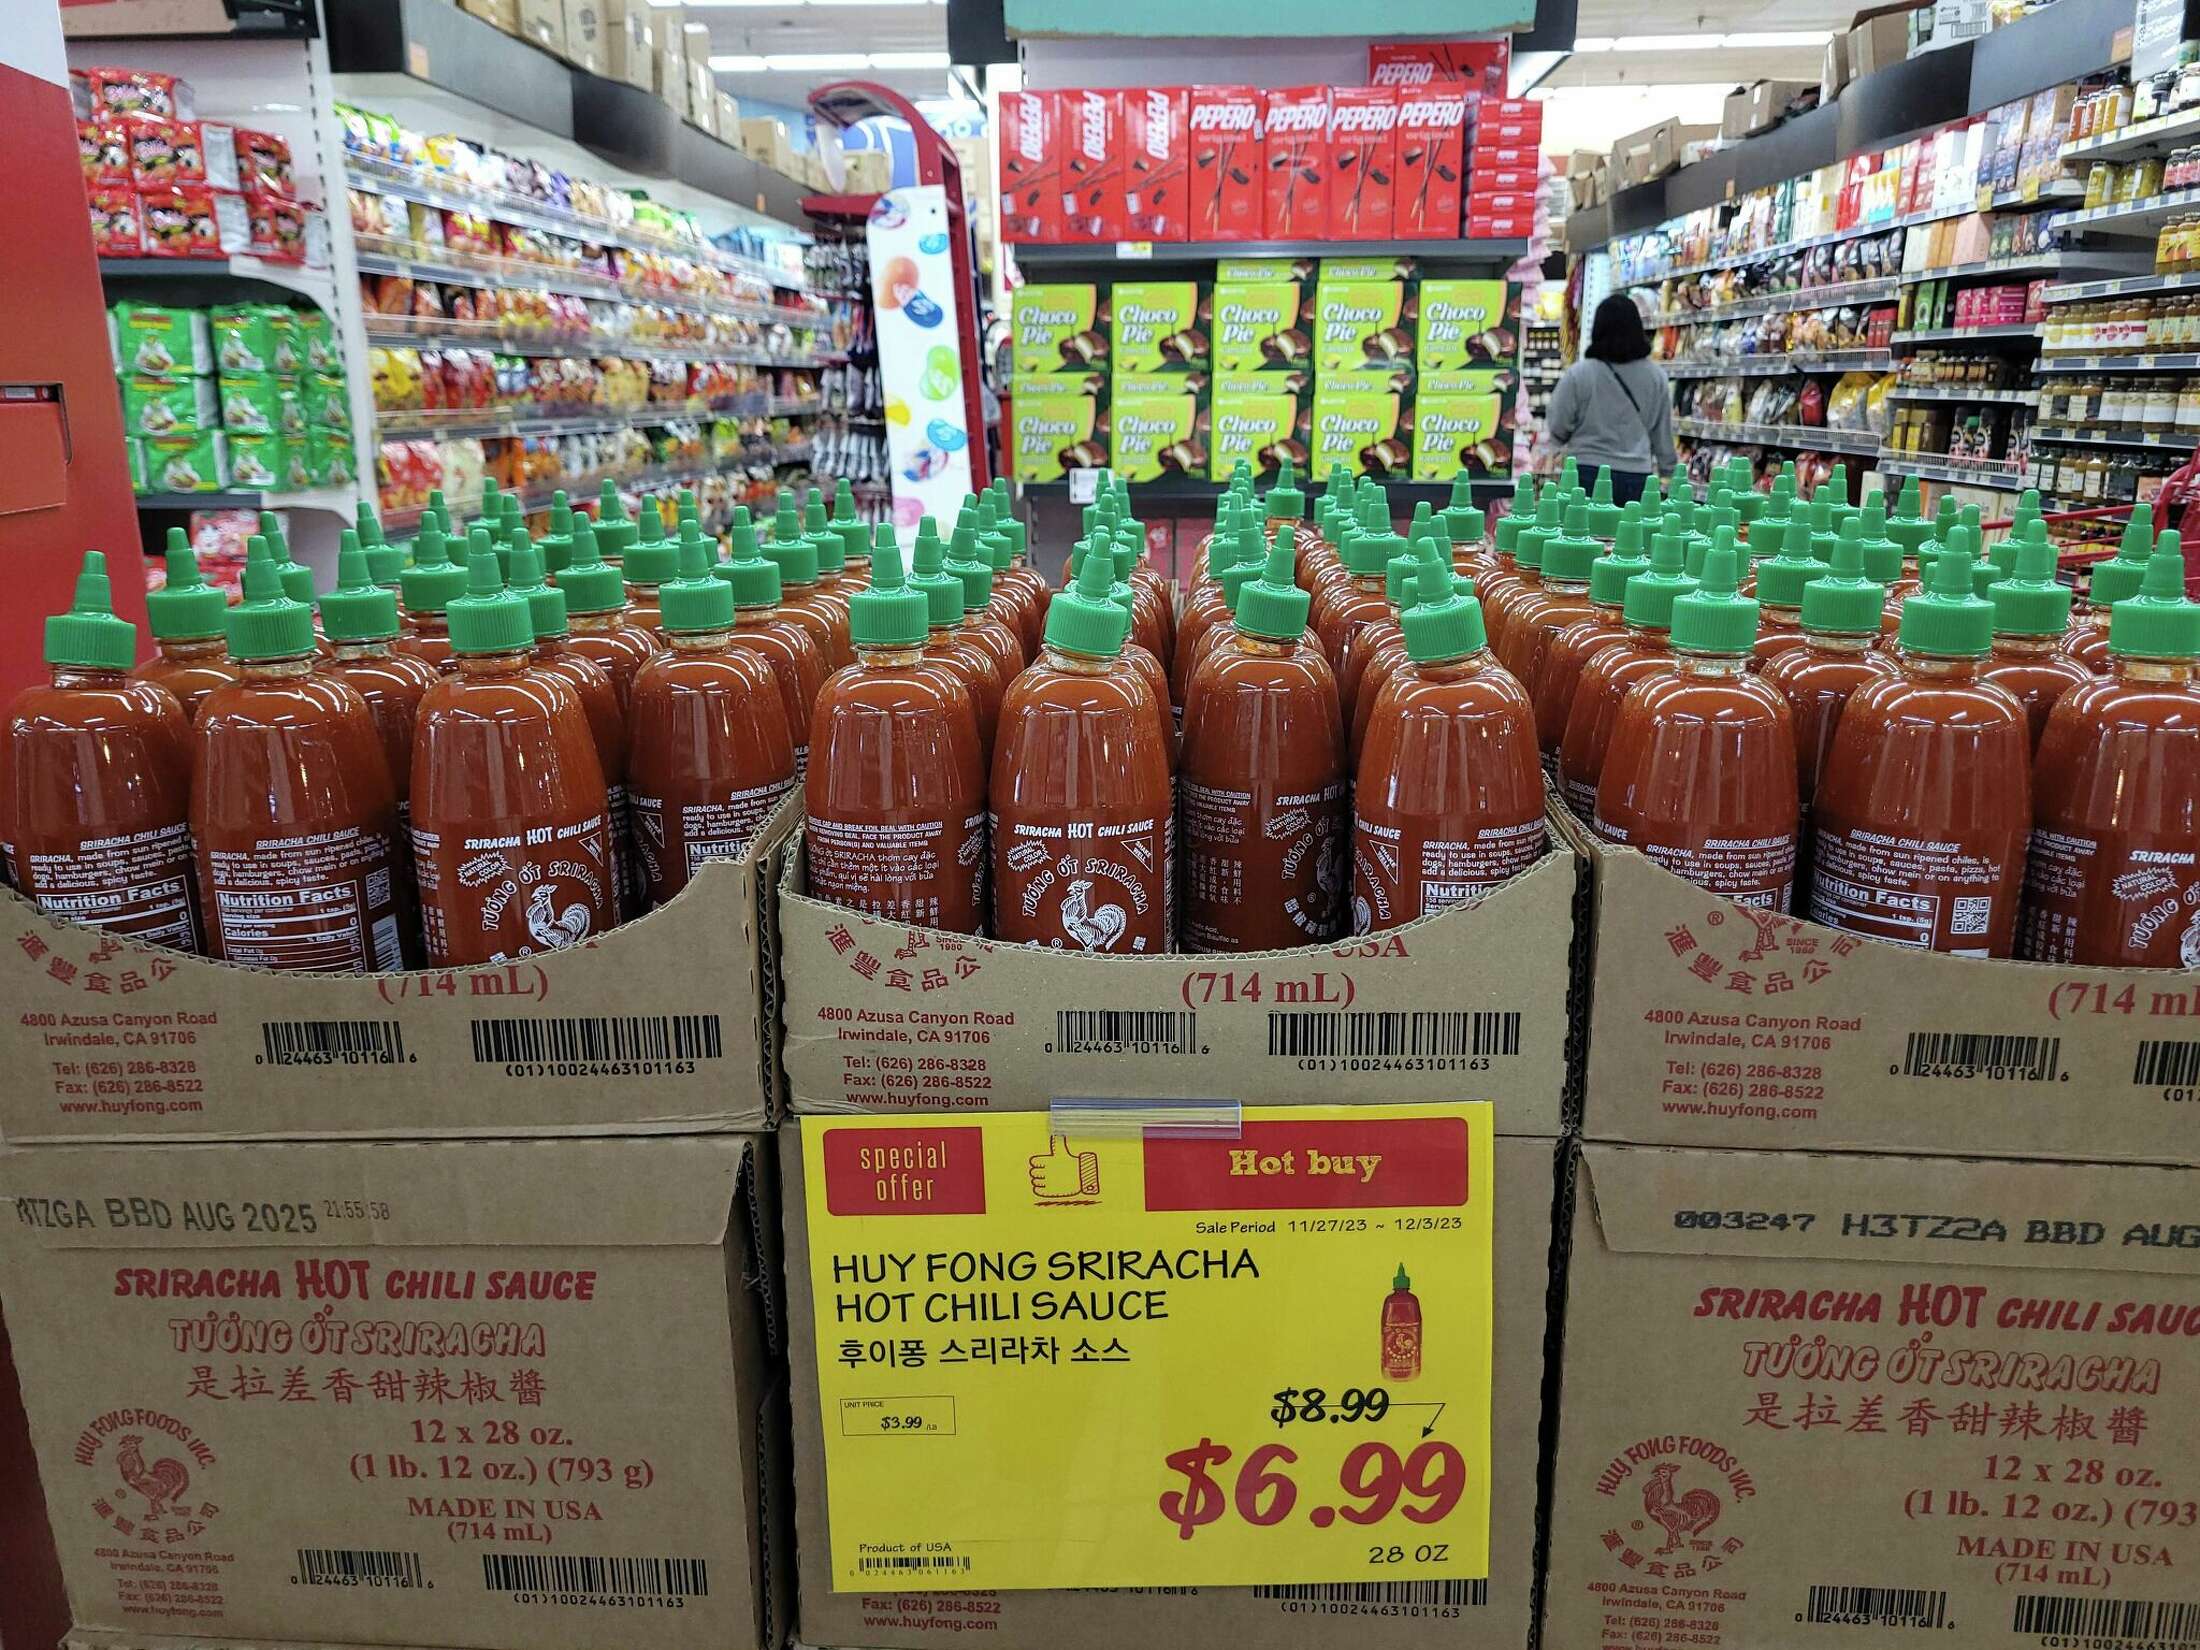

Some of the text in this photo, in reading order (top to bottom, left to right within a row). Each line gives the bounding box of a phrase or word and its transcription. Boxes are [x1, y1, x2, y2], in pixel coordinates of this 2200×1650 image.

[1373, 63, 1433, 86] PEPERO
[1190, 104, 1257, 130] PEPERO
[1265, 103, 1328, 132] PEPERO
[1331, 105, 1397, 131] PEPERO
[1398, 101, 1464, 127] PEPERO
[1018, 306, 1076, 326] Choco
[1119, 304, 1177, 324] Choco
[1220, 304, 1280, 324] Choco
[1323, 303, 1382, 322] Choco
[1426, 303, 1486, 322] Choco
[1022, 326, 1053, 346] Pie
[1121, 325, 1152, 344] Pie
[1222, 324, 1254, 344] Pie
[1324, 323, 1356, 342] Pie
[1428, 323, 1459, 342] Pie
[1018, 416, 1076, 436] Choco
[1118, 416, 1176, 435] Choco
[1218, 415, 1277, 434] Choco
[1320, 414, 1379, 433] Choco
[1421, 414, 1480, 433] Choco
[1022, 435, 1052, 455] Pie
[1121, 434, 1152, 454] Pie
[1220, 434, 1252, 454] Pie
[1322, 433, 1353, 452] Pie
[1423, 433, 1454, 452] Pie
[1014, 819, 1154, 838] SRIRACHA HOT CHILI SAUCE
[2129, 850, 2196, 864] SRIRACHA
[42, 881, 181, 909] Nutrition Facts
[219, 884, 352, 908] Nutrition Facts
[1086, 857, 1149, 915] SRIRACHA
[1875, 891, 1931, 910] Facts
[1181, 971, 1356, 1009] (714 mL)
[2048, 982, 2136, 1020] (714
[20, 1012, 217, 1029] 4800 Azusa Canyon Road
[817, 1007, 1015, 1028] 4800 Azusa Canyon Road
[45, 1032, 197, 1048] Irwindale, CA 91706
[838, 1027, 990, 1044] Irwindale, CA 91706
[1044, 1042, 1210, 1055] 0 24463 10116 6
[843, 1056, 986, 1072] Tel: (626) 286-8328
[1298, 1058, 1490, 1072] (01)10024463101163
[1666, 1060, 1822, 1080] Tel: (626) 286-8328
[843, 1074, 992, 1090] Fax: (626) 286-8522
[1662, 1080, 1824, 1100] Fax: (626) 286-8522
[60, 1100, 203, 1115] www.huyfong.com
[847, 1091, 988, 1108] www.huyfong.com
[1662, 1102, 1818, 1120] www.huyfong.com
[860, 1141, 947, 1172] special
[1228, 1150, 1382, 1182] Hot buy
[876, 1174, 934, 1201] offer
[105, 1198, 172, 1230] BBD
[183, 1201, 235, 1232] AUG
[243, 1202, 318, 1234] 2025
[1196, 1221, 1227, 1234] Sale
[1230, 1220, 1276, 1234] Period
[1287, 1218, 1368, 1233] 11/27/23
[1394, 1217, 1462, 1230] 12/3/23
[2024, 1218, 2105, 1246] BBD
[833, 1248, 1260, 1284] HUY FONG SRIRACHA
[114, 1259, 597, 1300] SRIRACHA HOT CHILI SAUCE
[837, 1290, 1169, 1322] HOT CHILI SAUCE
[1694, 1283, 2103, 1333] SRIRACHA HOT CHILI
[350, 1320, 546, 1358] SRIRACHA
[838, 1336, 1131, 1368] 후이퐁 스리라차 소스
[186, 1363, 547, 1407] 是拉差香甜辣椒醬
[1270, 1387, 1390, 1428] $8.99
[880, 1416, 922, 1431] $3.99
[1742, 1392, 2148, 1446] 是拉差香甜辣椒醬
[74, 1408, 216, 1470] HUY FONG FOODS INC.
[410, 1420, 574, 1447] 12 x 28 oz.
[350, 1454, 654, 1490] (1 lb. 12 oz.) (793 g)
[1158, 1437, 1467, 1541] $6.99
[408, 1496, 604, 1521] MADE IN USA
[859, 1542, 952, 1554] Product of USA
[1368, 1544, 1450, 1564] 28 OZ
